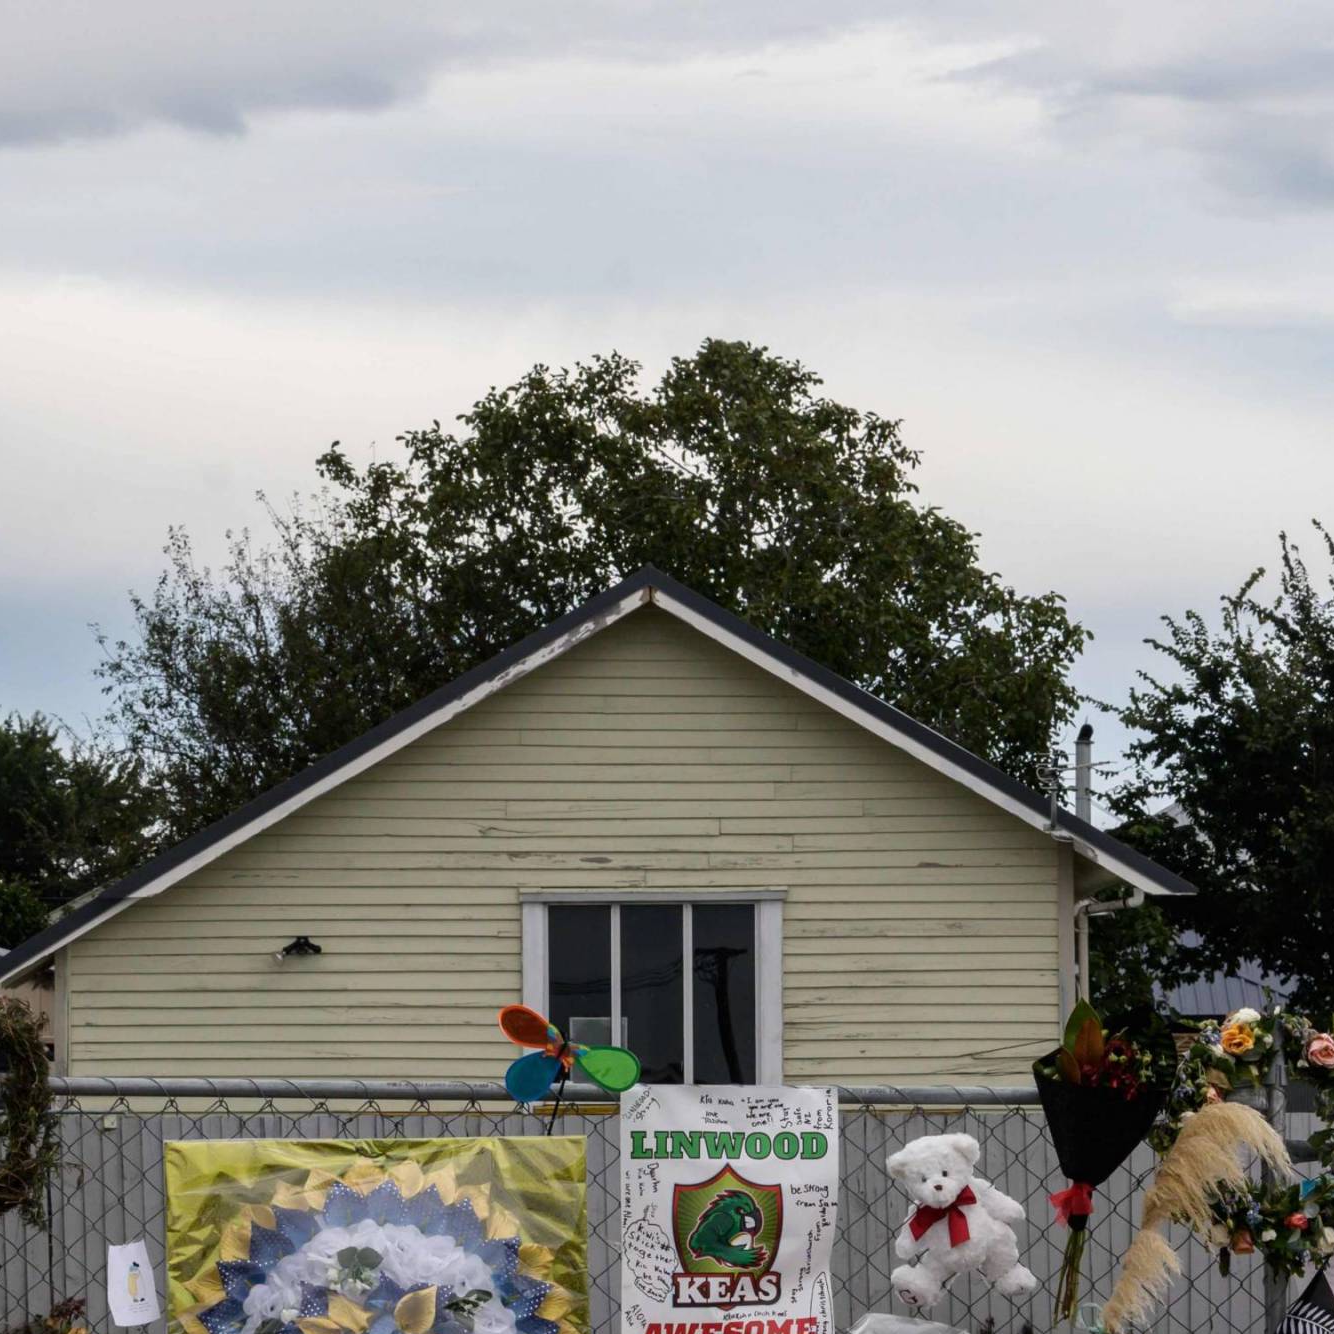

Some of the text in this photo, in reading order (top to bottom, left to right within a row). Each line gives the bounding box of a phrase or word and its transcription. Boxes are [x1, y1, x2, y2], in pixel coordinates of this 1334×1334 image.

[631, 1131, 829, 1159] LINWOOD
[790, 1184, 803, 1195] be
[675, 1275, 780, 1305] KEAS
